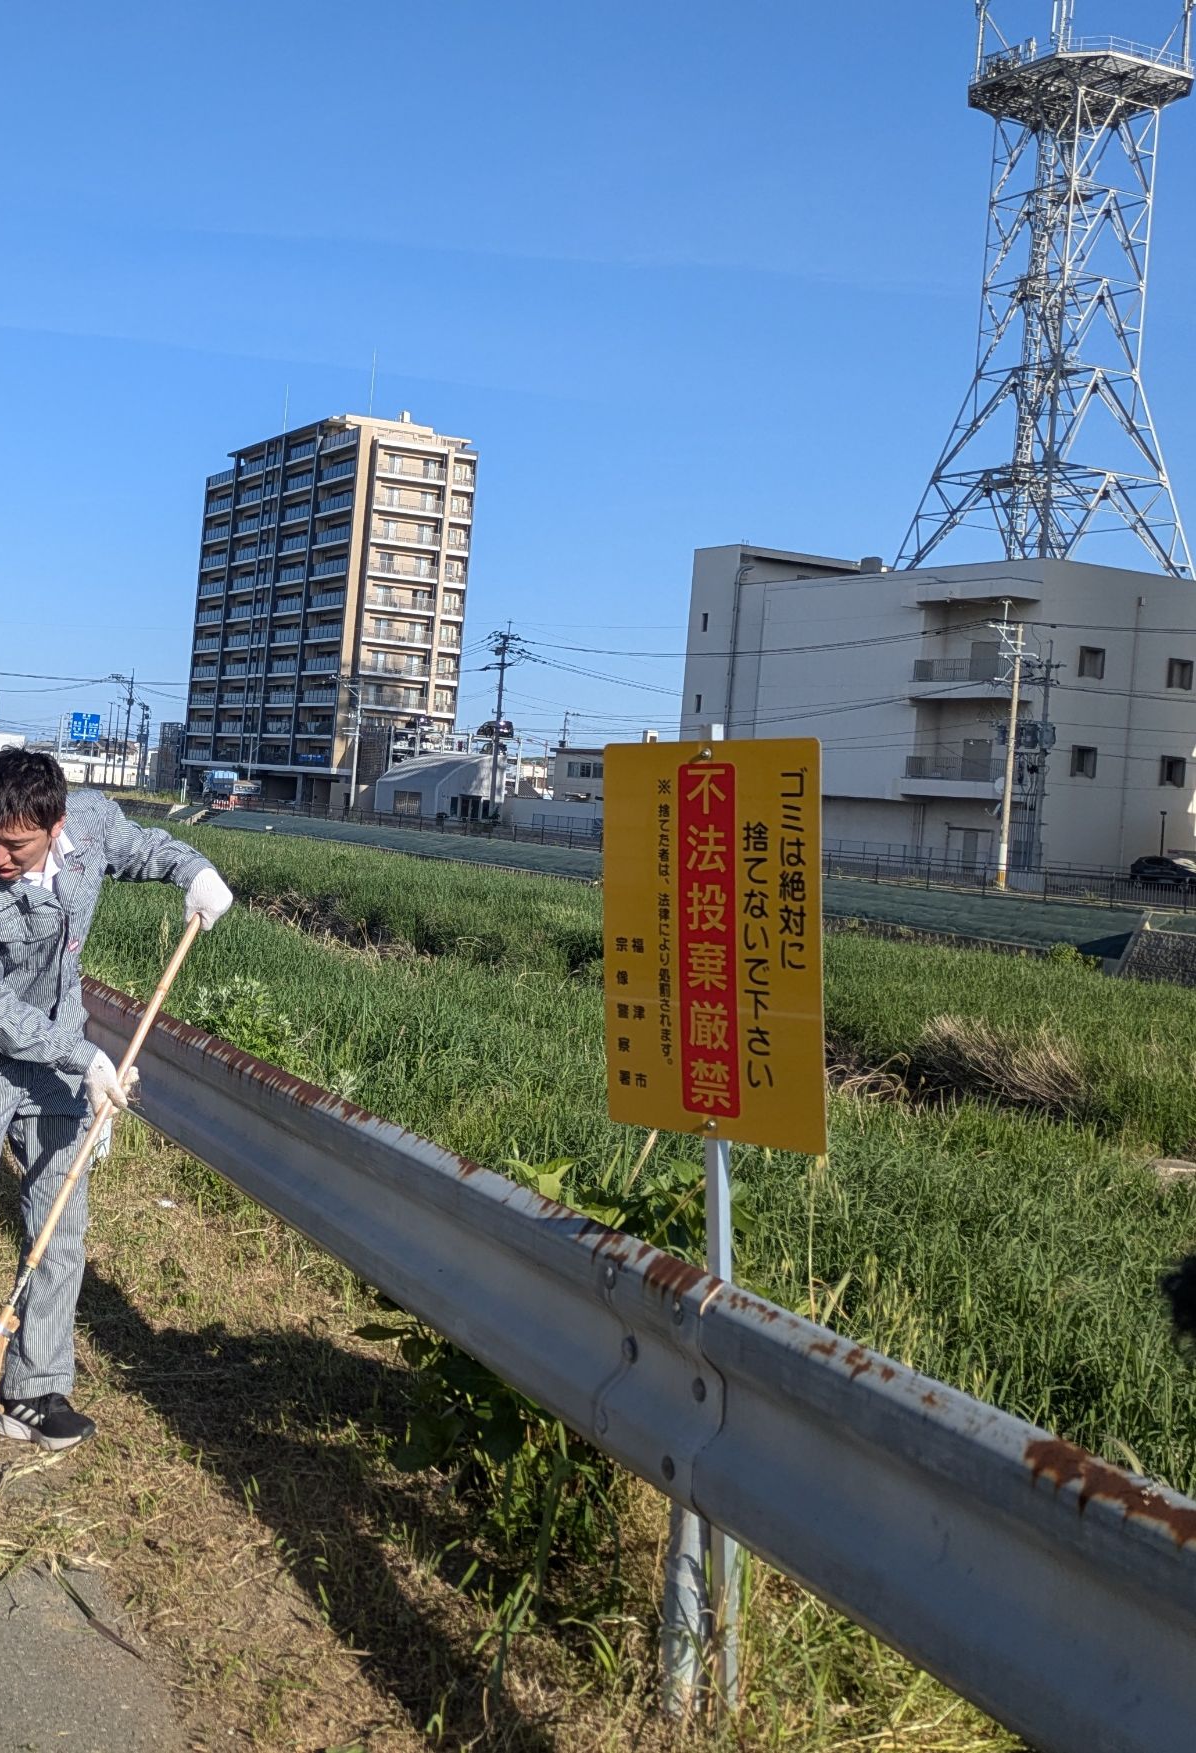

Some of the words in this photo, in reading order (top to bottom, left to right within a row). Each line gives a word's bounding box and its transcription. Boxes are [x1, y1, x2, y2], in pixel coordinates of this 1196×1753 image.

[686, 768, 731, 1109] 不法投棄厳禁
[742, 821, 773, 1088] 捨てないで下さい
[778, 767, 808, 970] ゴミは絶対に
[615, 937, 631, 1087] 宗像警察署
[631, 937, 647, 1088] 福津市
